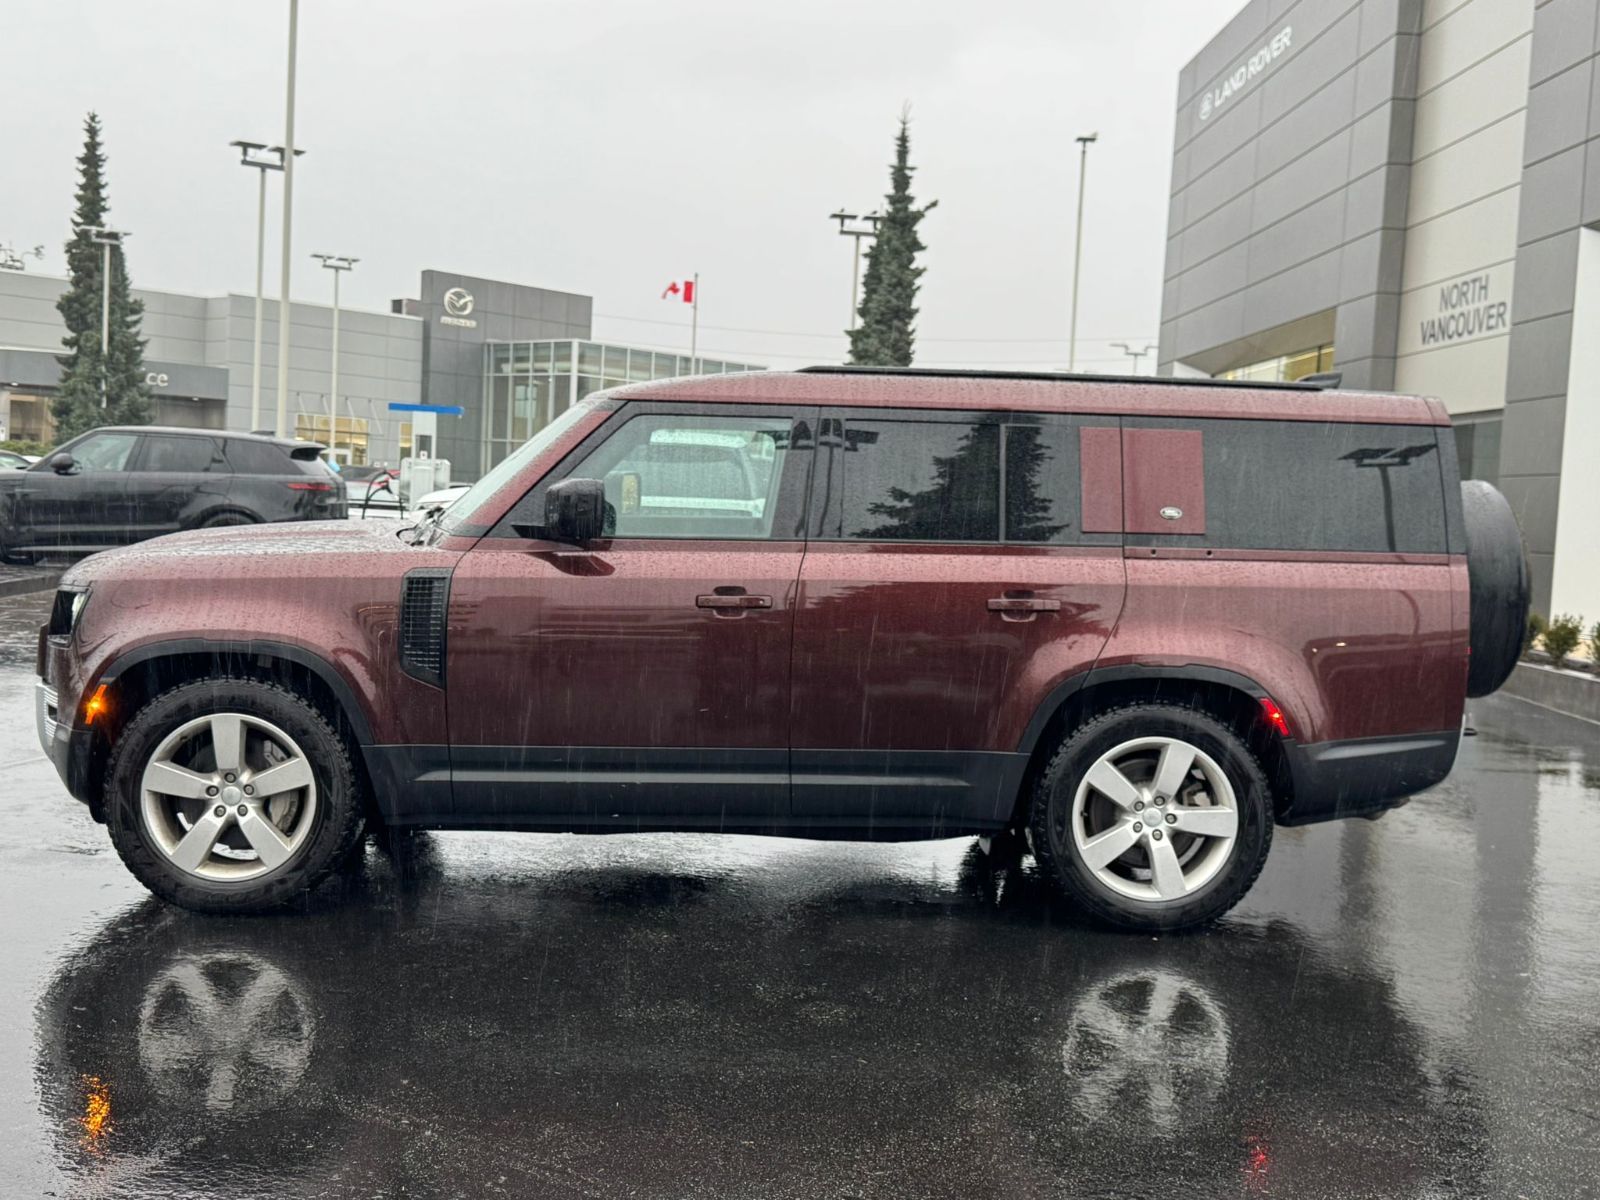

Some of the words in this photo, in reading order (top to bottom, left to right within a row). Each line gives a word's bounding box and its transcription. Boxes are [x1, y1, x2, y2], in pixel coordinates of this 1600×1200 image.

[1214, 65, 1247, 107] LAND
[1247, 25, 1292, 80] ROVER
[1439, 274, 1489, 312] NORTH
[1420, 301, 1507, 345] VANCOUVER
